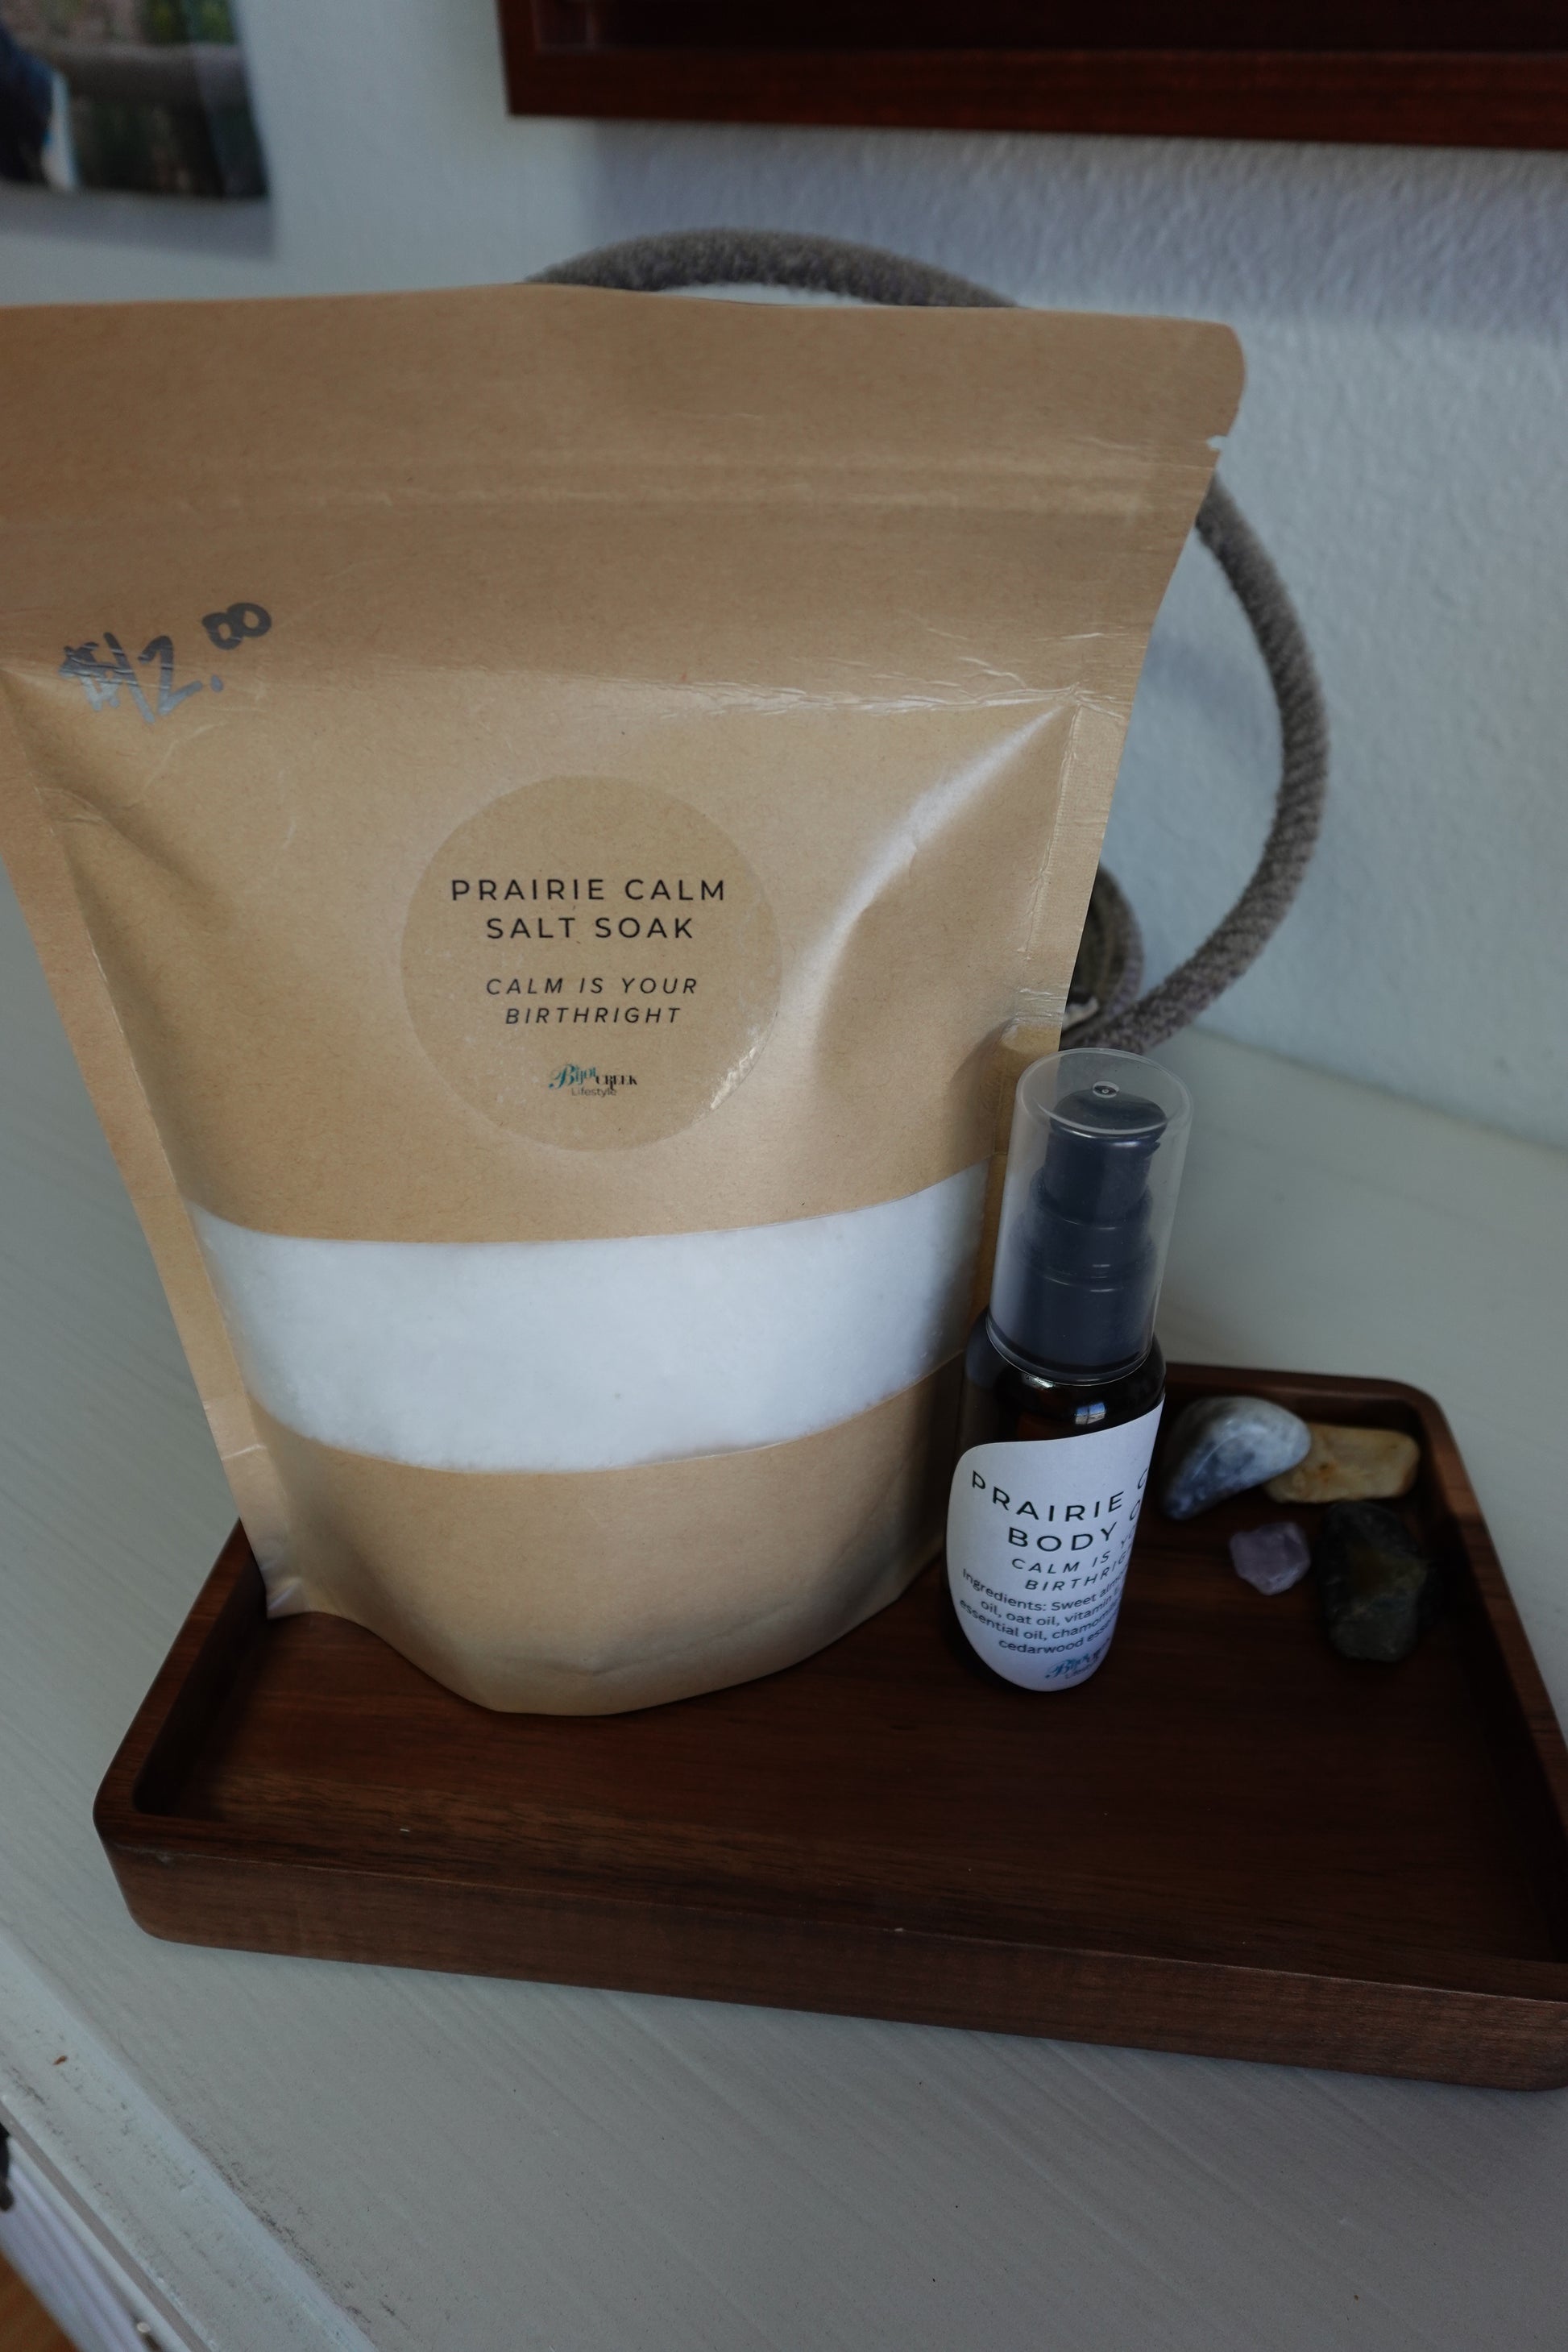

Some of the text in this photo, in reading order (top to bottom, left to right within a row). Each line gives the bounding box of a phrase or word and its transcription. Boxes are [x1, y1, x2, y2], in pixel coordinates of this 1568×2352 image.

[452, 879, 724, 901] PRAIRIE CALM
[487, 917, 693, 939] SALT SOAK
[486, 977, 697, 995] CALM IS YOUR
[506, 1007, 681, 1025] BIRTHRIGHT
[571, 1086, 617, 1097] Lifestyle
[972, 1470, 1124, 1522] PRAIRIE
[1008, 1521, 1117, 1552] BODY
[1011, 1558, 1080, 1574] CALM
[1092, 1550, 1110, 1568] IS
[1024, 1547, 1130, 1591] BIRTHRIG
[963, 1568, 1047, 1612] Ingredients:
[1051, 1595, 1097, 1612] Sweet
[960, 1599, 1018, 1637] essential
[1024, 1626, 1047, 1641] oil,
[981, 1599, 1002, 1619] oil,
[1006, 1612, 1031, 1625] oat
[1036, 1612, 1060, 1627] oil,
[1064, 1595, 1113, 1624] vitamin
[998, 1636, 1084, 1654] cedarwood
